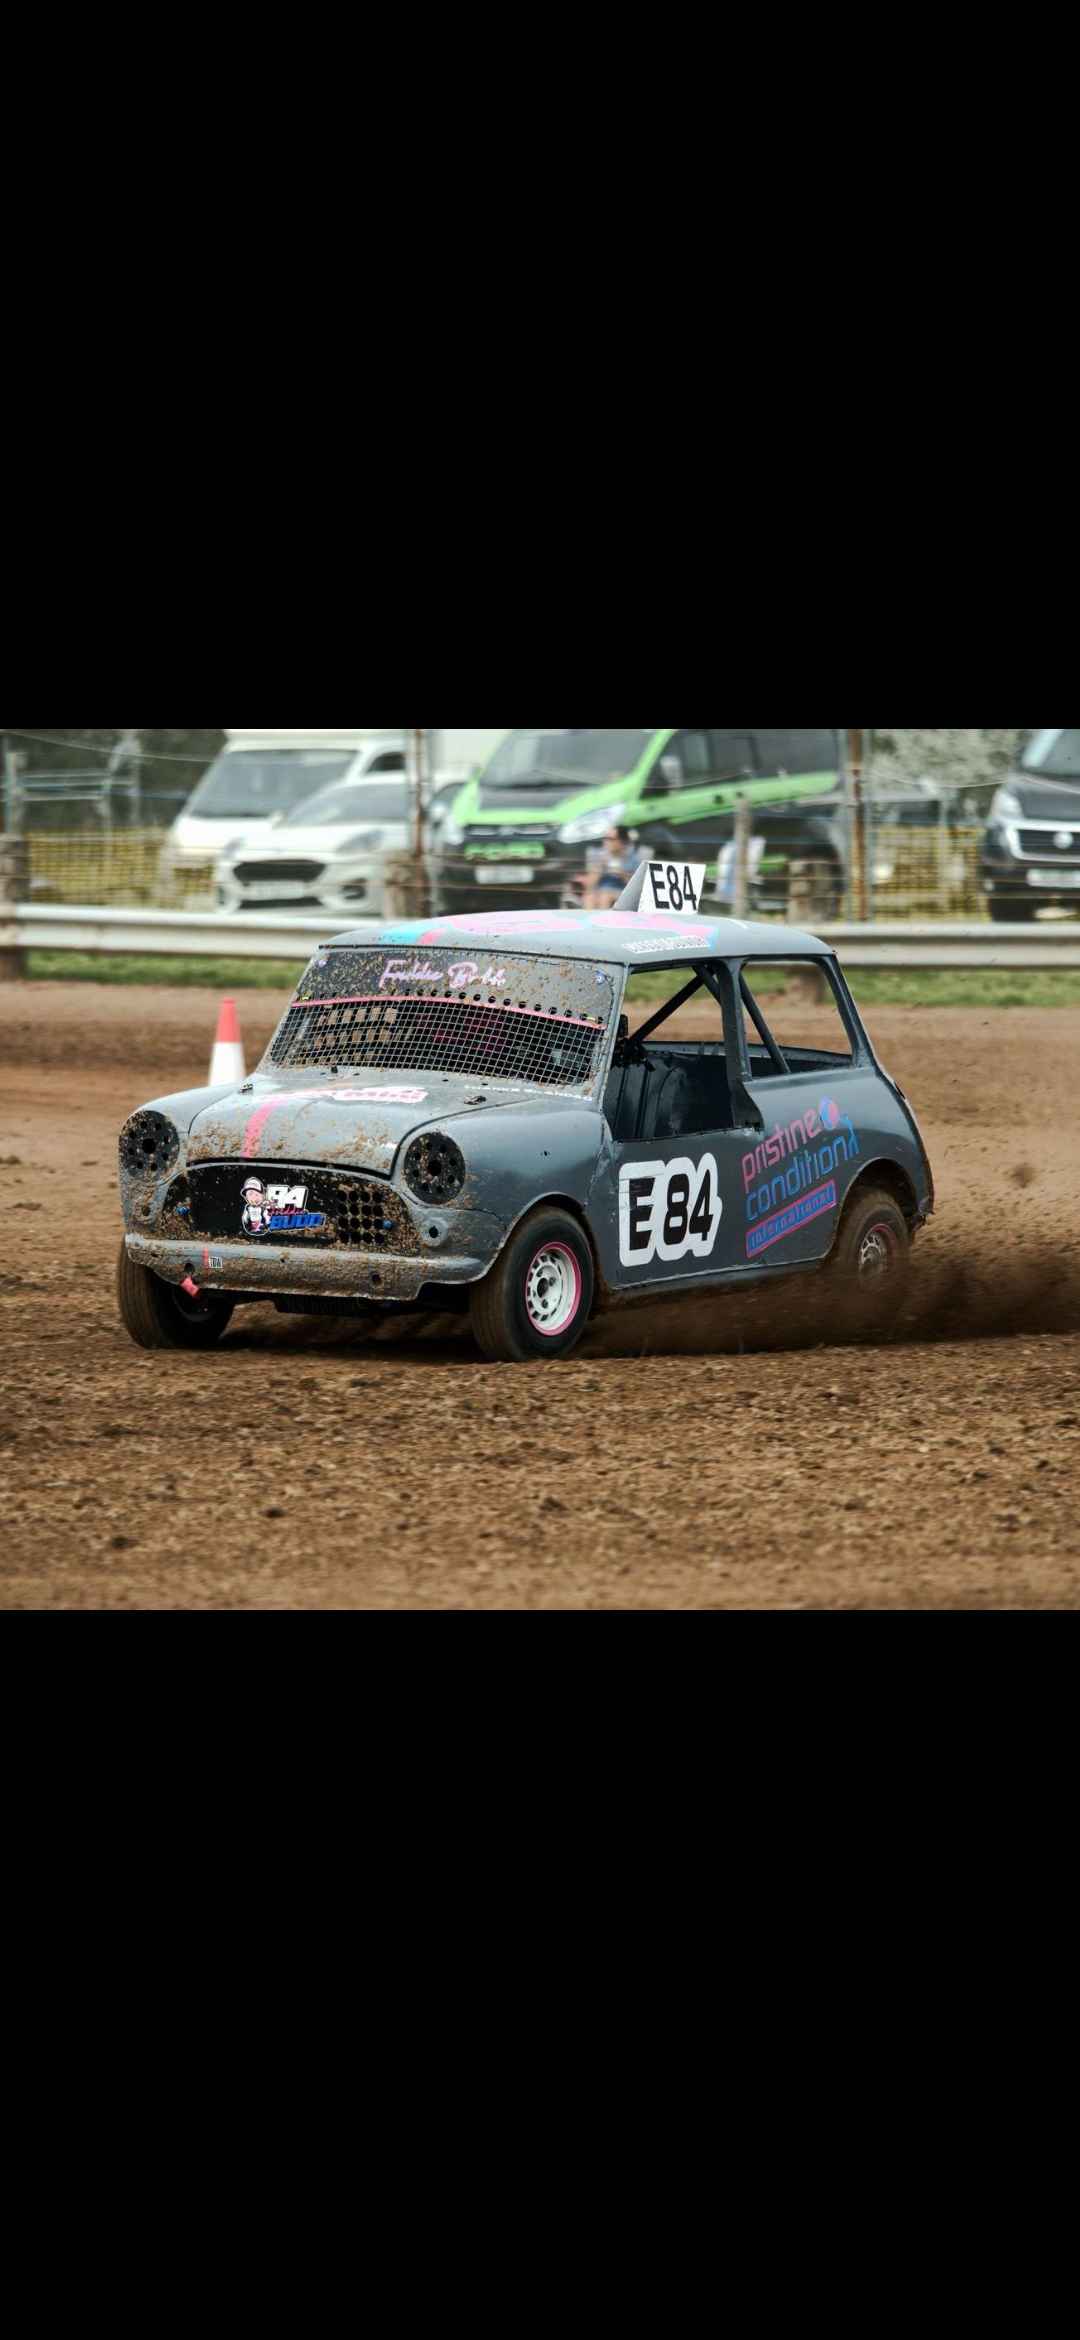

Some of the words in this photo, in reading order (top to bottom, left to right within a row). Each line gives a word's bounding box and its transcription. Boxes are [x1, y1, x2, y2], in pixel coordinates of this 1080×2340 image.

[649, 863, 697, 911] E84
[741, 1108, 822, 1194] pristine
[629, 1169, 713, 1251] E84
